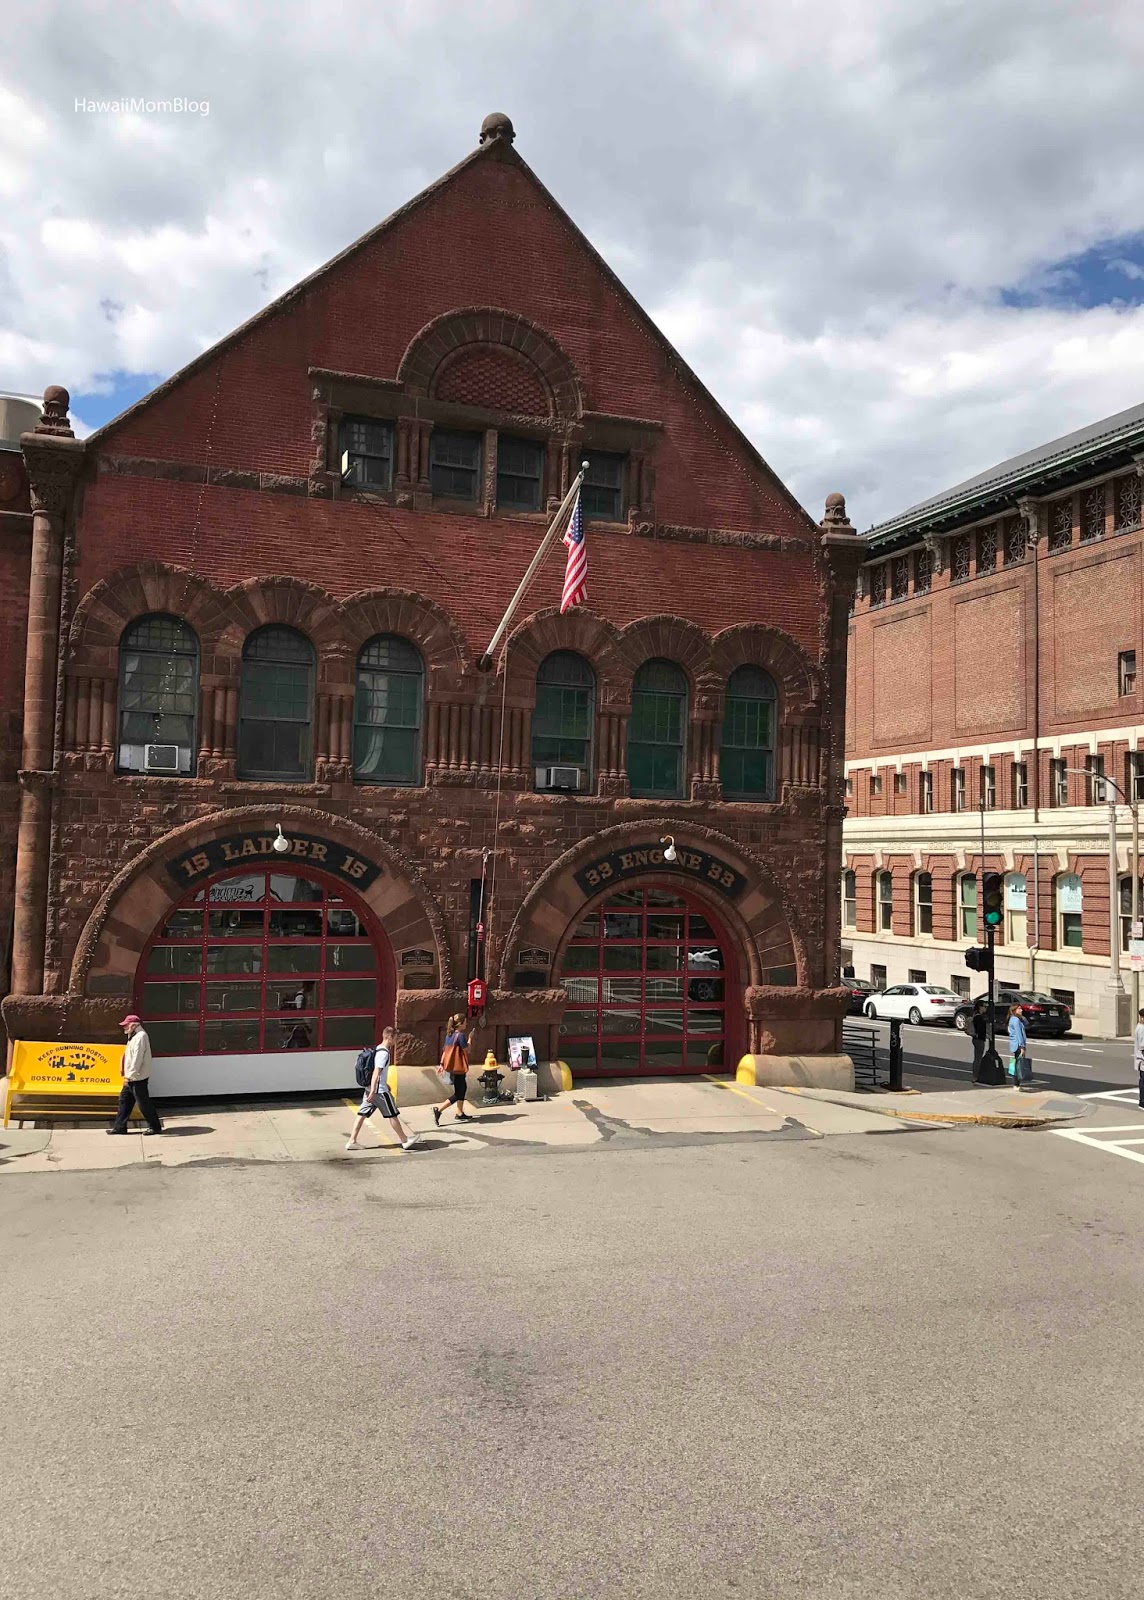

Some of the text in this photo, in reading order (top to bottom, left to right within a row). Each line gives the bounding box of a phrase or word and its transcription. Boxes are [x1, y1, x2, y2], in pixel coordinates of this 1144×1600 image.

[181, 851, 210, 877] 15
[340, 855, 368, 879] 15
[586, 849, 735, 888] 33 ENGNE 33
[38, 1049, 54, 1062] KEEP
[86, 1047, 108, 1064] BOSTON
